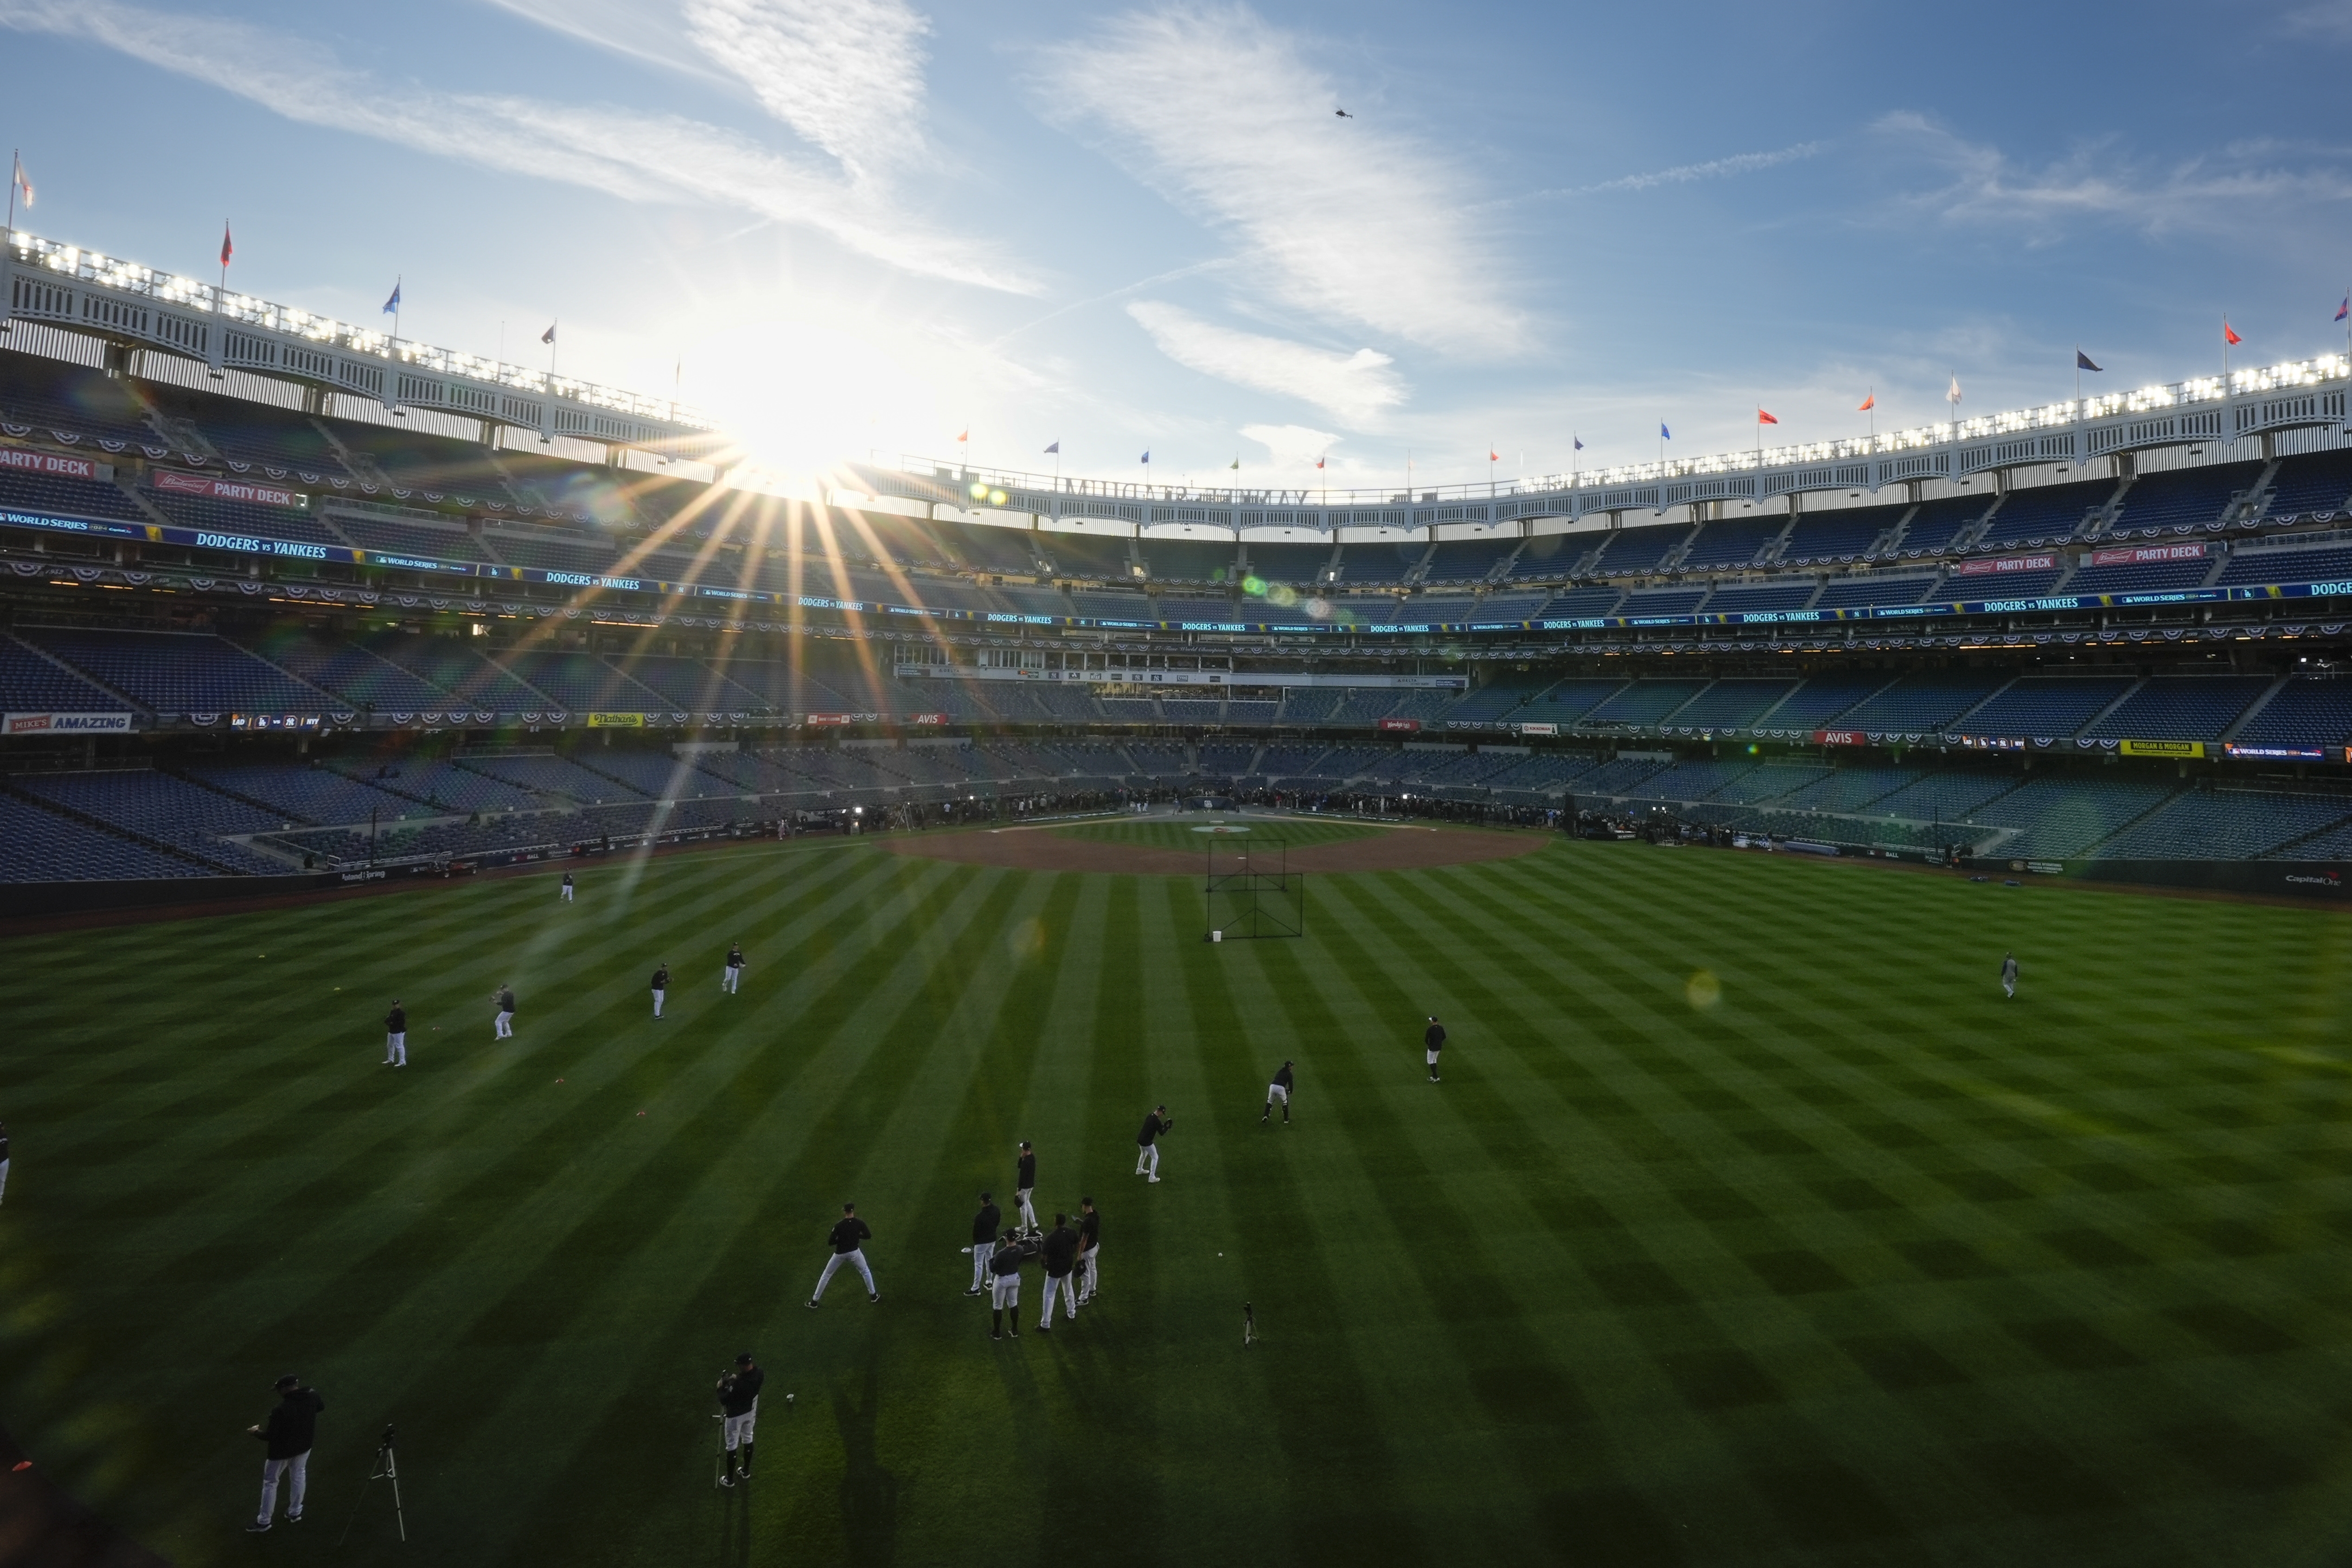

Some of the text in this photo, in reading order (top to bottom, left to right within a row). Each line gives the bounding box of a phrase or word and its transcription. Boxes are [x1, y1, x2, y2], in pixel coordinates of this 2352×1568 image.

[0, 450, 89, 476] ARTY DECK
[165, 476, 204, 489] Budweiser
[214, 483, 290, 505] PARTY DECK
[7, 514, 49, 525] WORLD
[50, 518, 88, 530] SERIES
[196, 533, 260, 551] DODGERS
[274, 542, 326, 558] YANKEES
[2136, 546, 2199, 560] PARTY DECK
[388, 557, 413, 566] WORLD
[414, 561, 438, 569] SERIES
[1997, 557, 2050, 570] PARTY DECK
[546, 572, 591, 585] DODGERS
[601, 577, 639, 590] YANKEES
[798, 597, 829, 608] DODGERS
[836, 600, 863, 611] YANKEES
[1984, 601, 2026, 612] DODGERS
[2036, 598, 2078, 609] YANKEES
[988, 614, 1017, 622] DODGERS
[1024, 615, 1052, 624] YANKEES
[1744, 613, 1777, 622] DODGERS
[1786, 612, 1819, 621] YANKEES
[15, 720, 47, 730] MIKE'S
[54, 718, 126, 729] AMAZING
[594, 714, 637, 723] Nathan's
[917, 715, 938, 723] AVIS
[1825, 733, 1852, 743] AVIS
